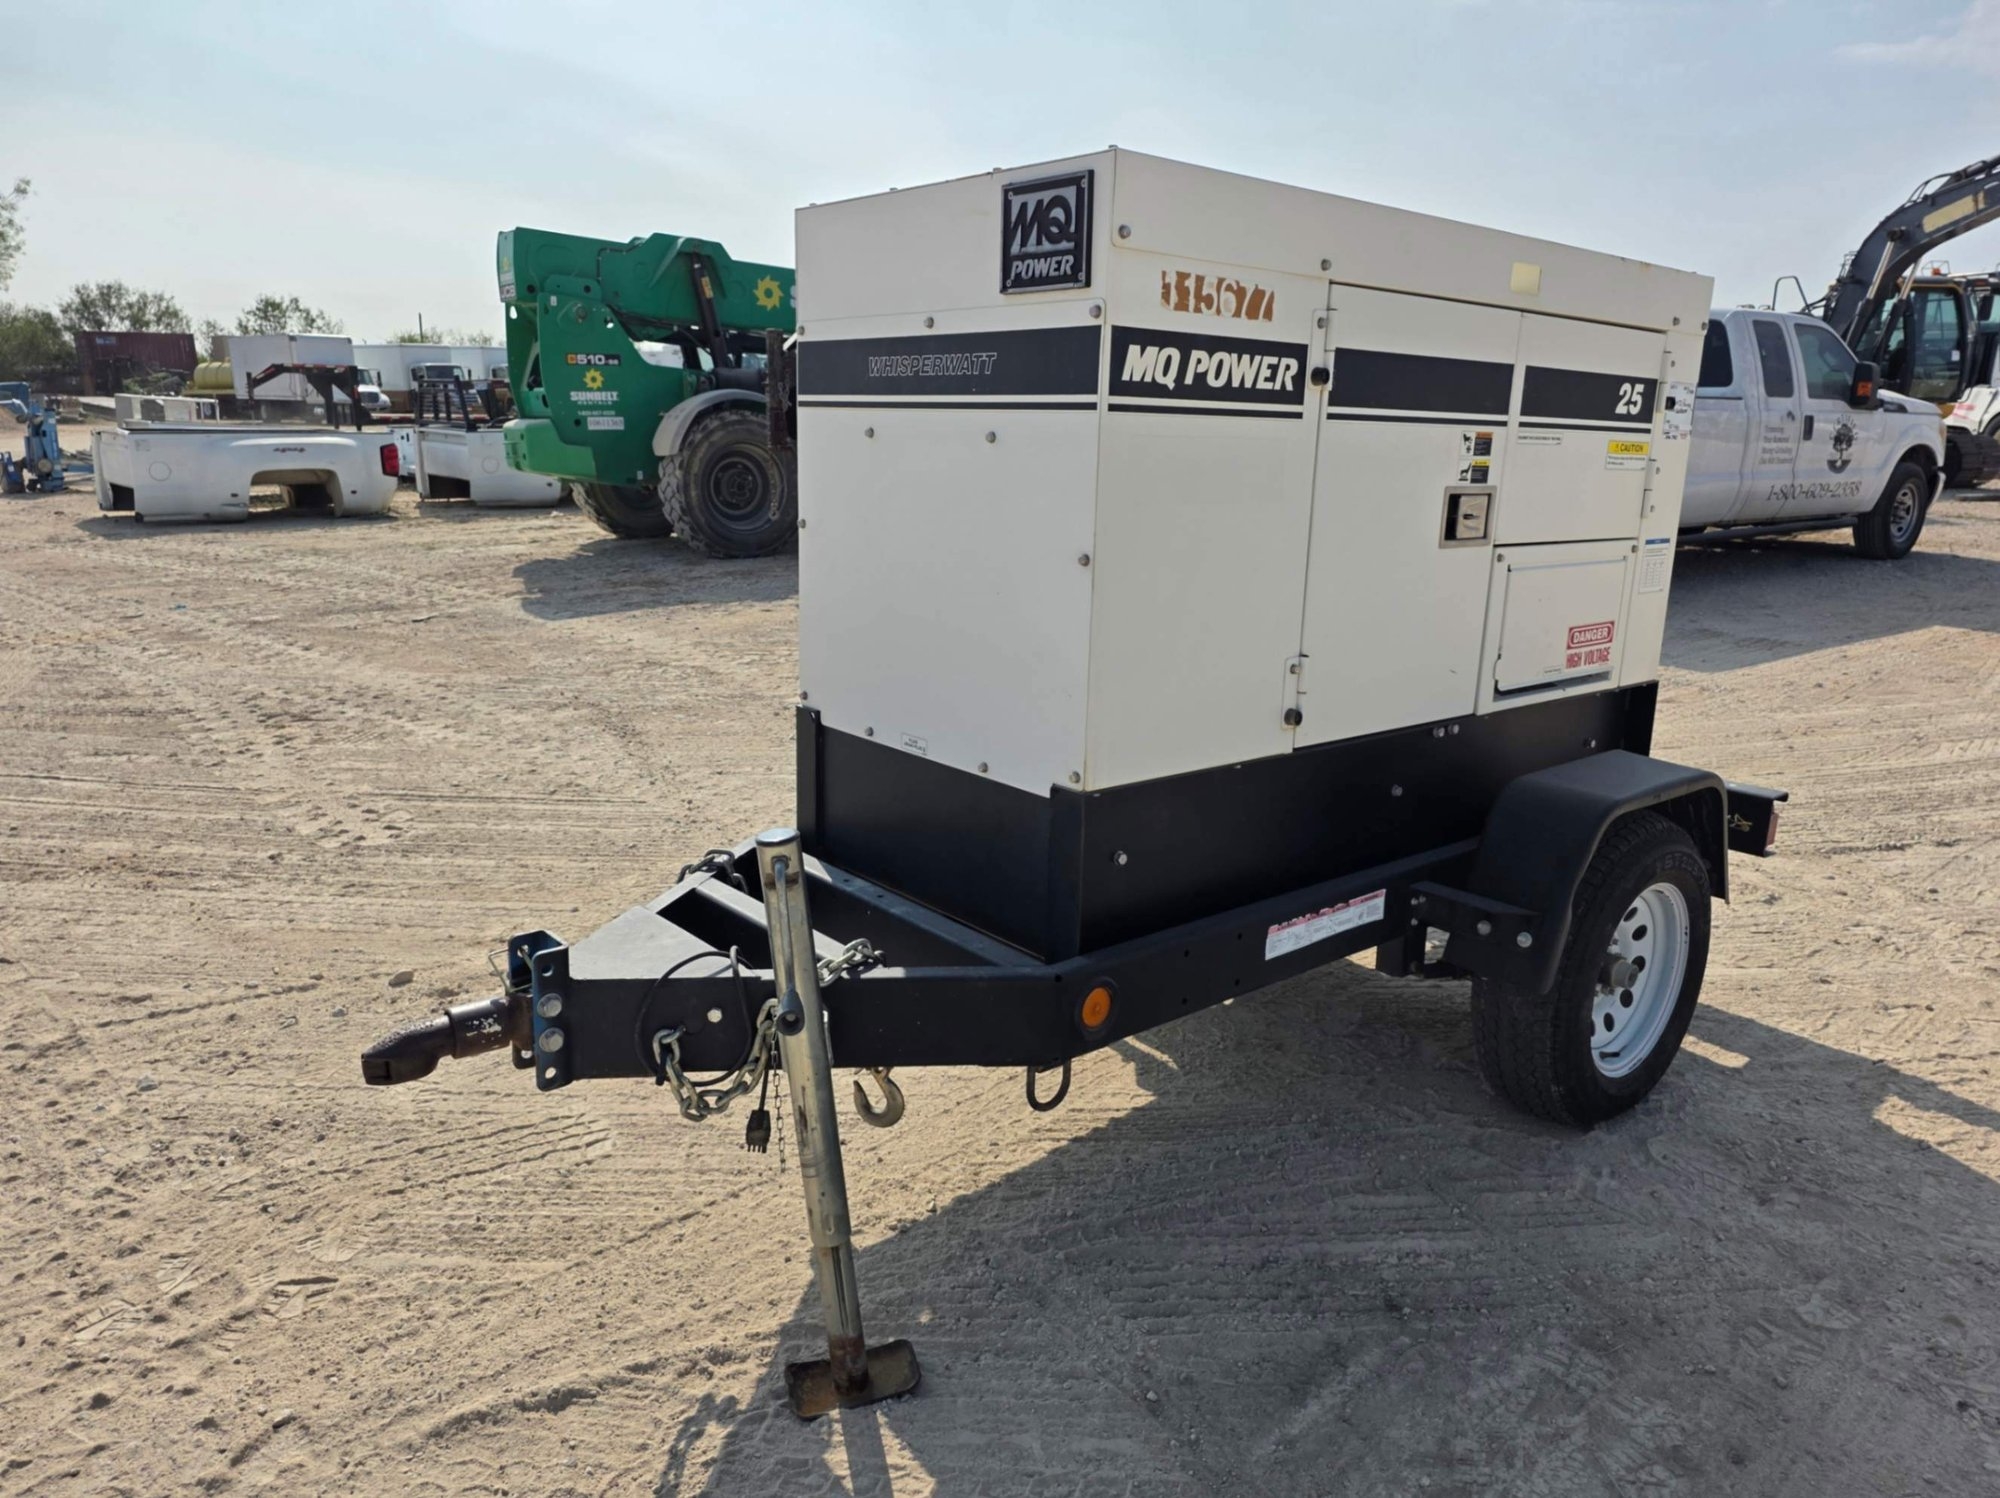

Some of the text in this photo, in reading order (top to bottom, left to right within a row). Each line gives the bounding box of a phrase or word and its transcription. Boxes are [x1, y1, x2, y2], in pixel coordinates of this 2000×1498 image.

[1008, 194, 1077, 249] MQ
[1011, 254, 1075, 281] POWER
[868, 352, 998, 377] WHISPERWATT
[1121, 344, 1299, 392] MQ POWER
[570, 391, 619, 401] SUNBELT
[1614, 382, 1645, 415] 25
[1619, 442, 1644, 453] CAUTION
[1572, 627, 1609, 644] DANGER
[1583, 646, 1611, 666] VOLTAGE
